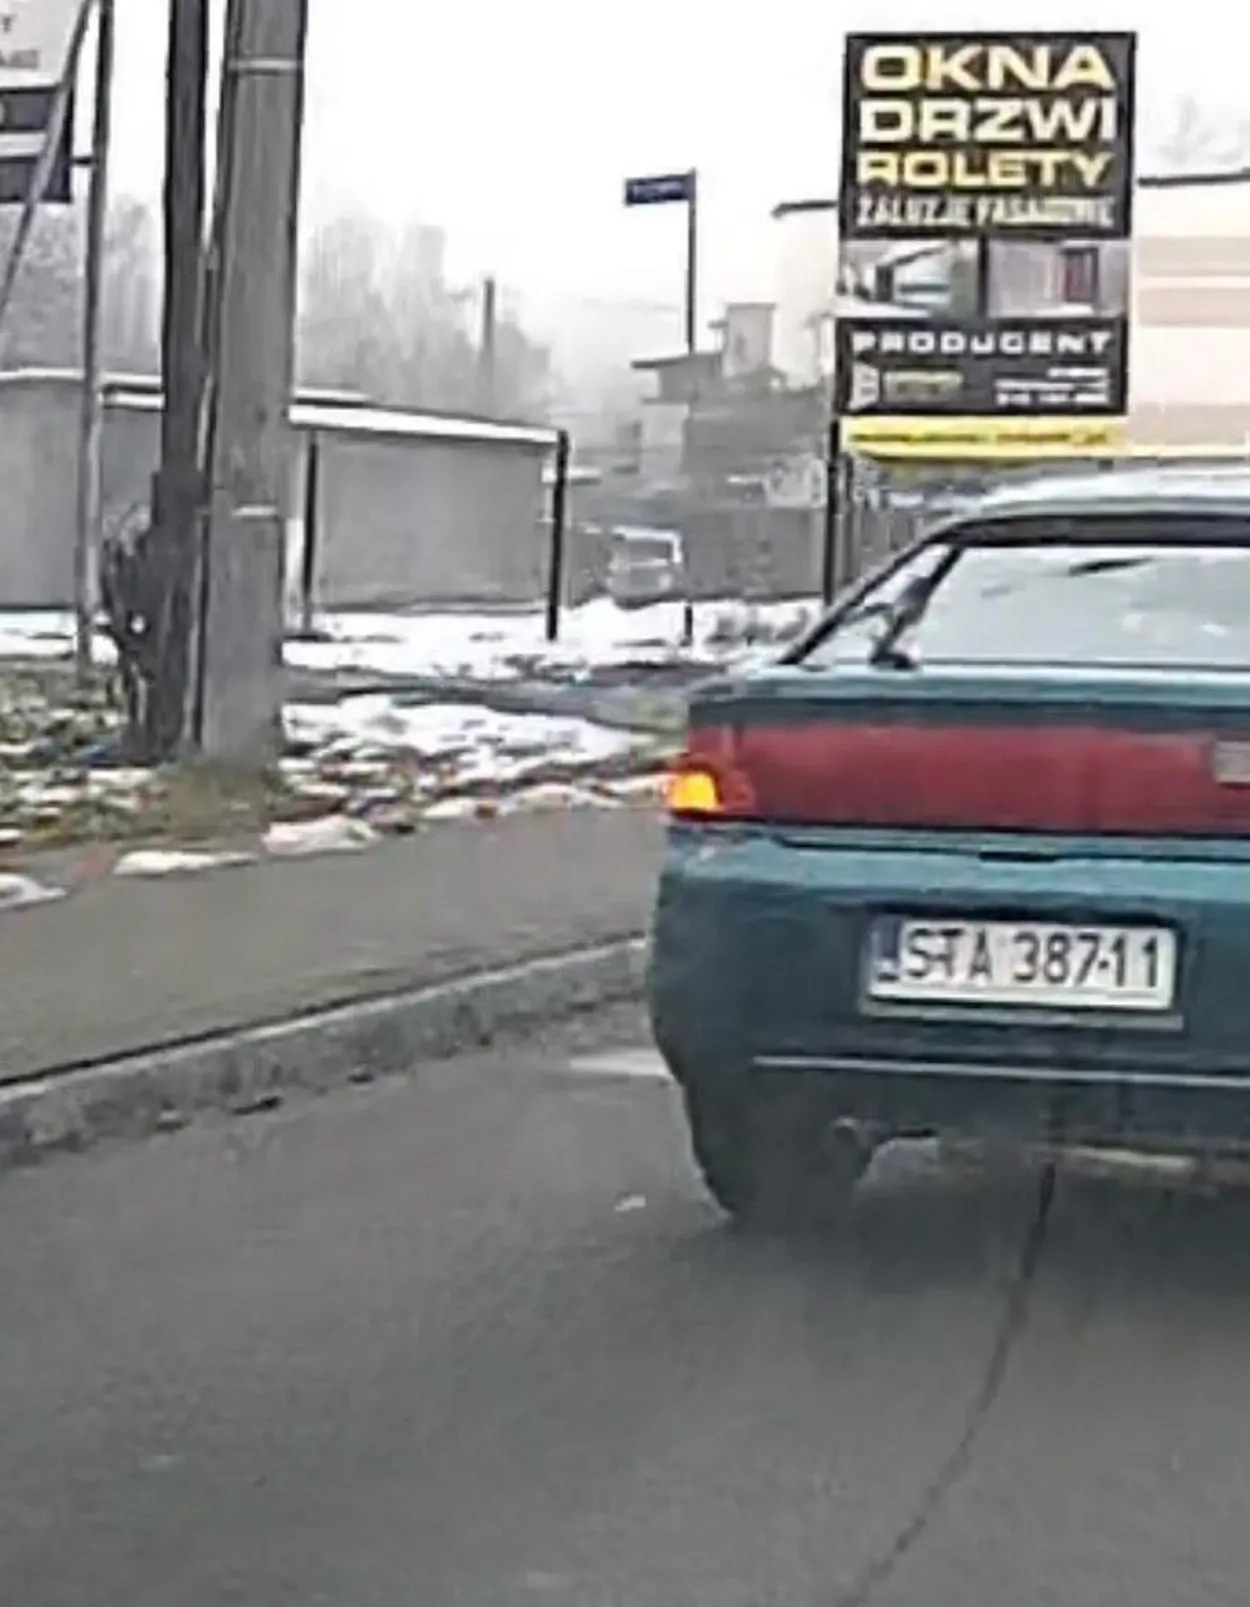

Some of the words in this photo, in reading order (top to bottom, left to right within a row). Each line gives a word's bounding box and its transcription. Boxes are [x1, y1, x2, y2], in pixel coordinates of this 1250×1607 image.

[861, 45, 1115, 91] OKNA
[859, 98, 1117, 142] DRZWI
[857, 151, 1115, 187] ROLETY
[852, 331, 1111, 354] PRODUCENT
[907, 927, 993, 980] STA
